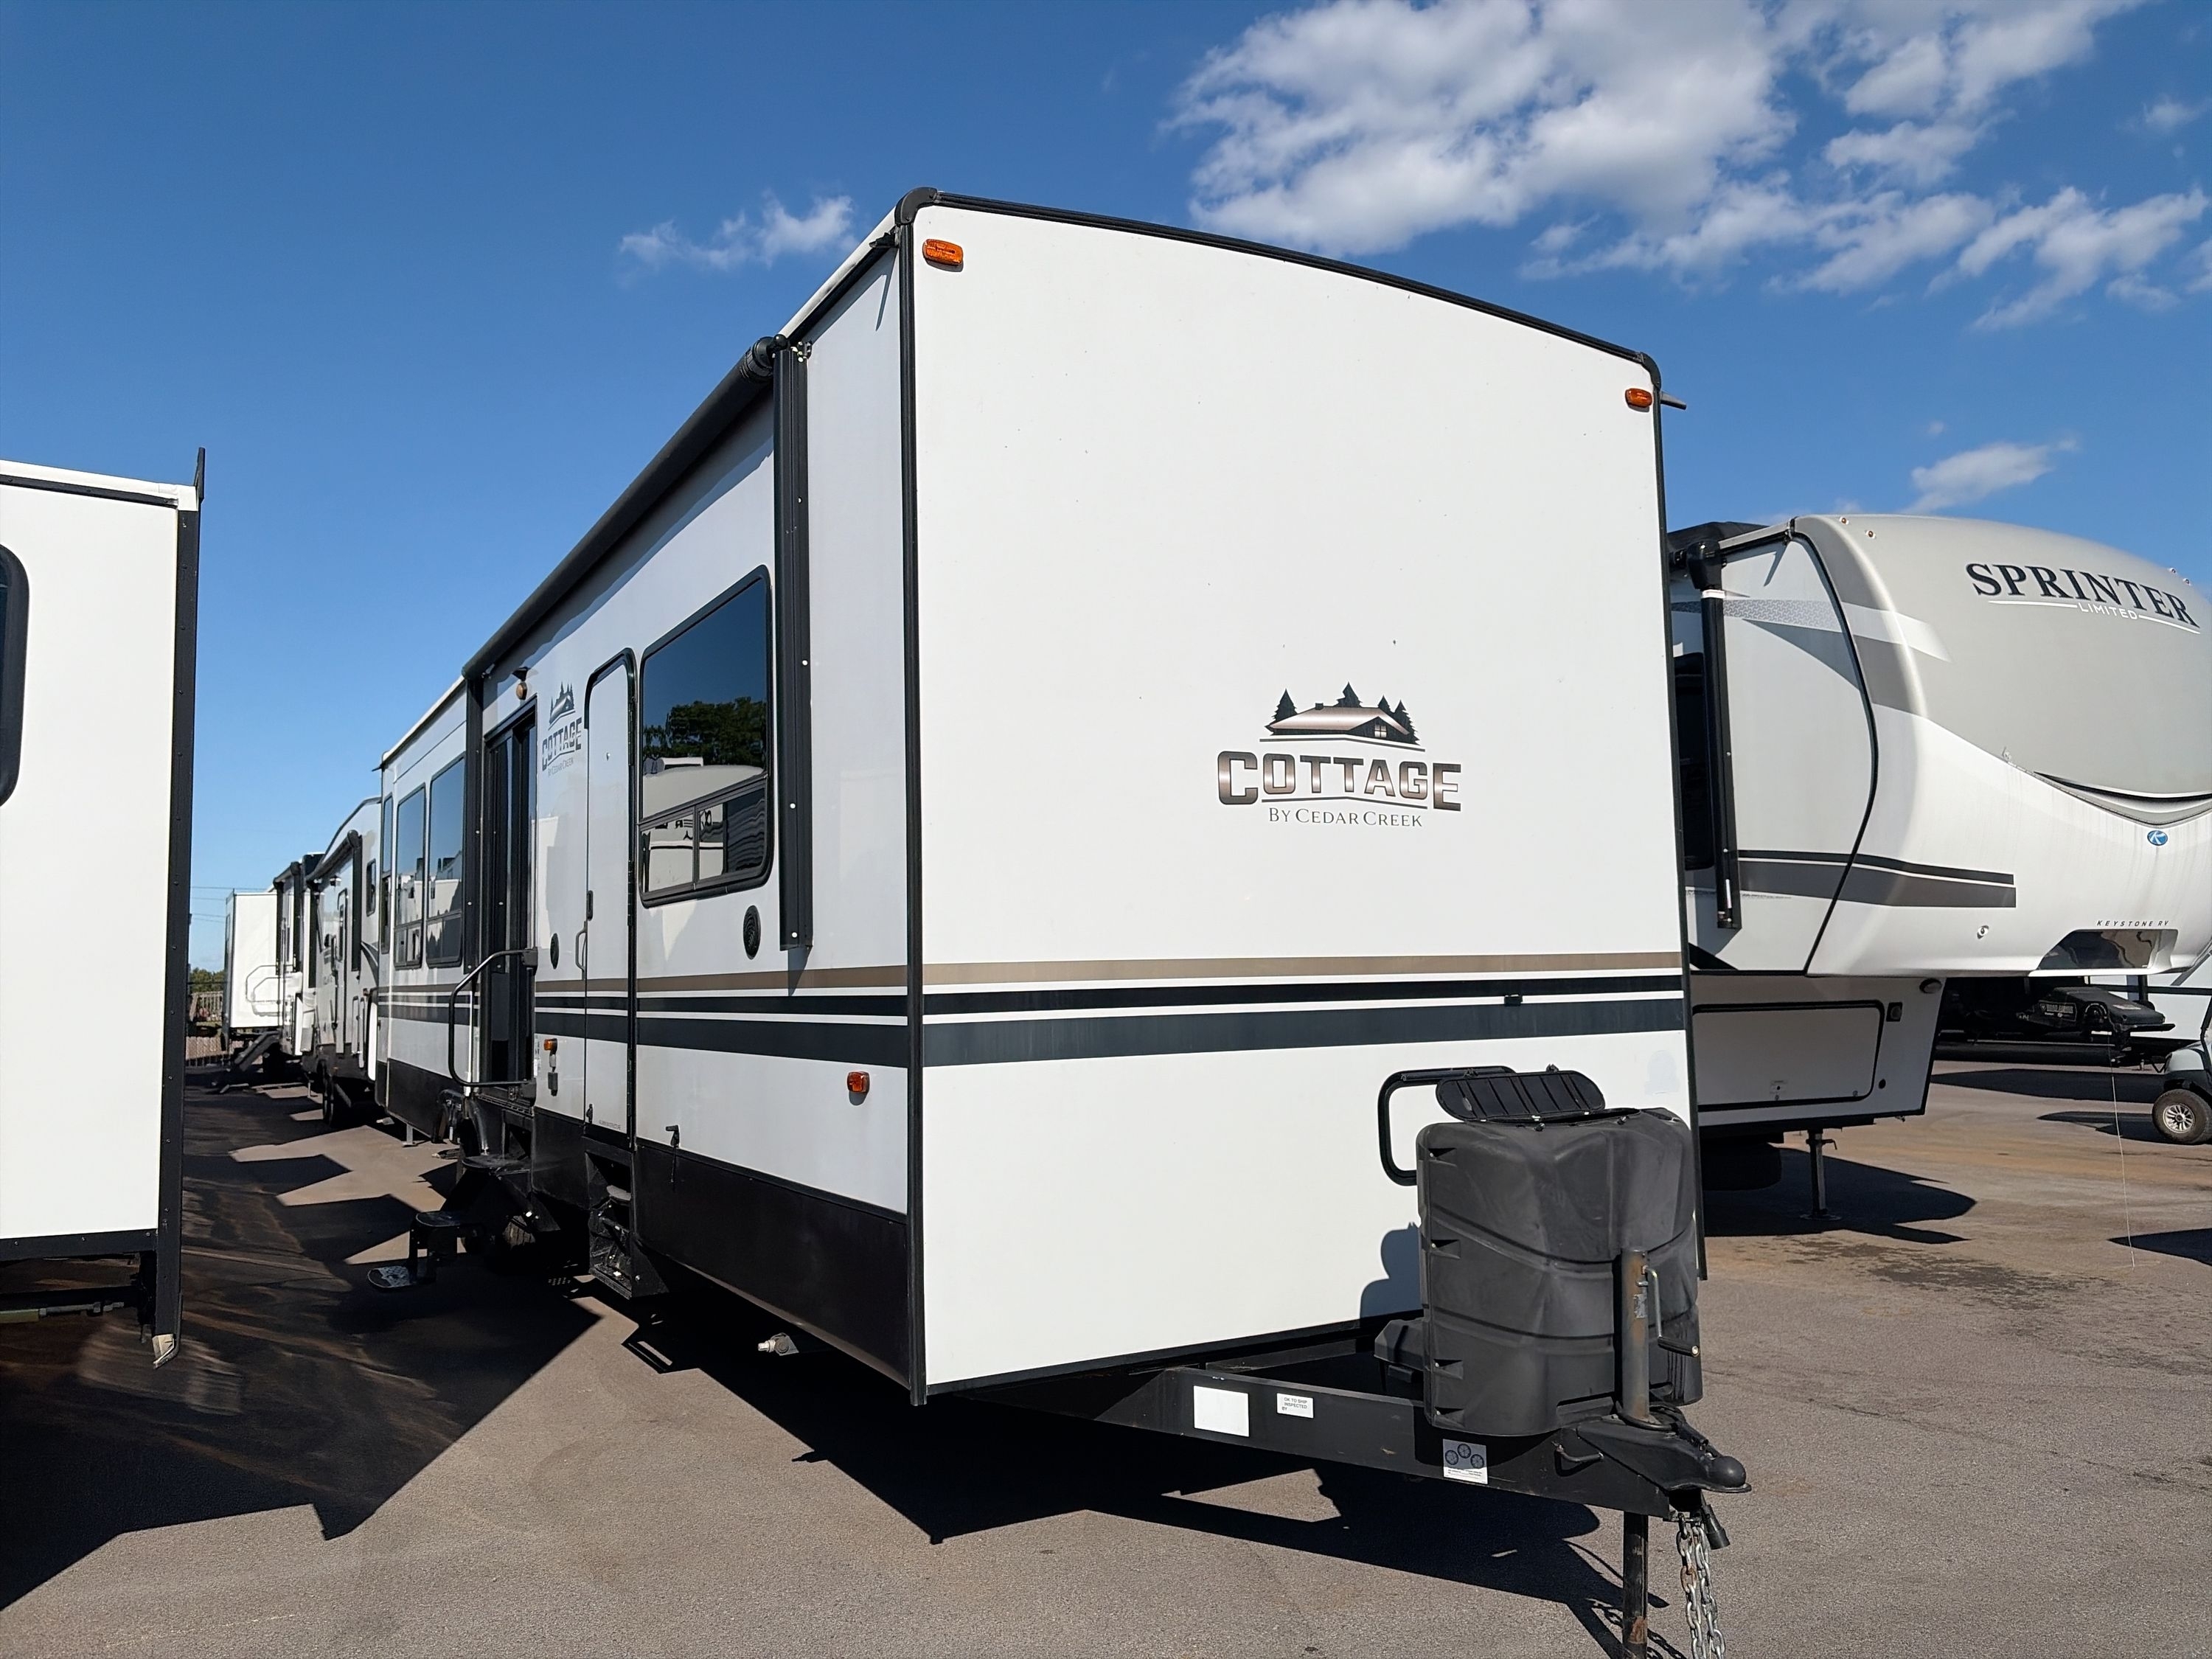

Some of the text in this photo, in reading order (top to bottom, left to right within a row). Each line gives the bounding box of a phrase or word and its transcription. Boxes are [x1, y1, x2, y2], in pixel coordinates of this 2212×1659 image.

[1966, 563, 2200, 628] SPRINTER
[2077, 602, 2138, 620] LIMITED
[542, 717, 582, 771] COTTAGE
[1217, 751, 1461, 812] COTTAGE
[1295, 808, 1359, 825] CEDAR
[1363, 811, 1423, 827] CREEK
